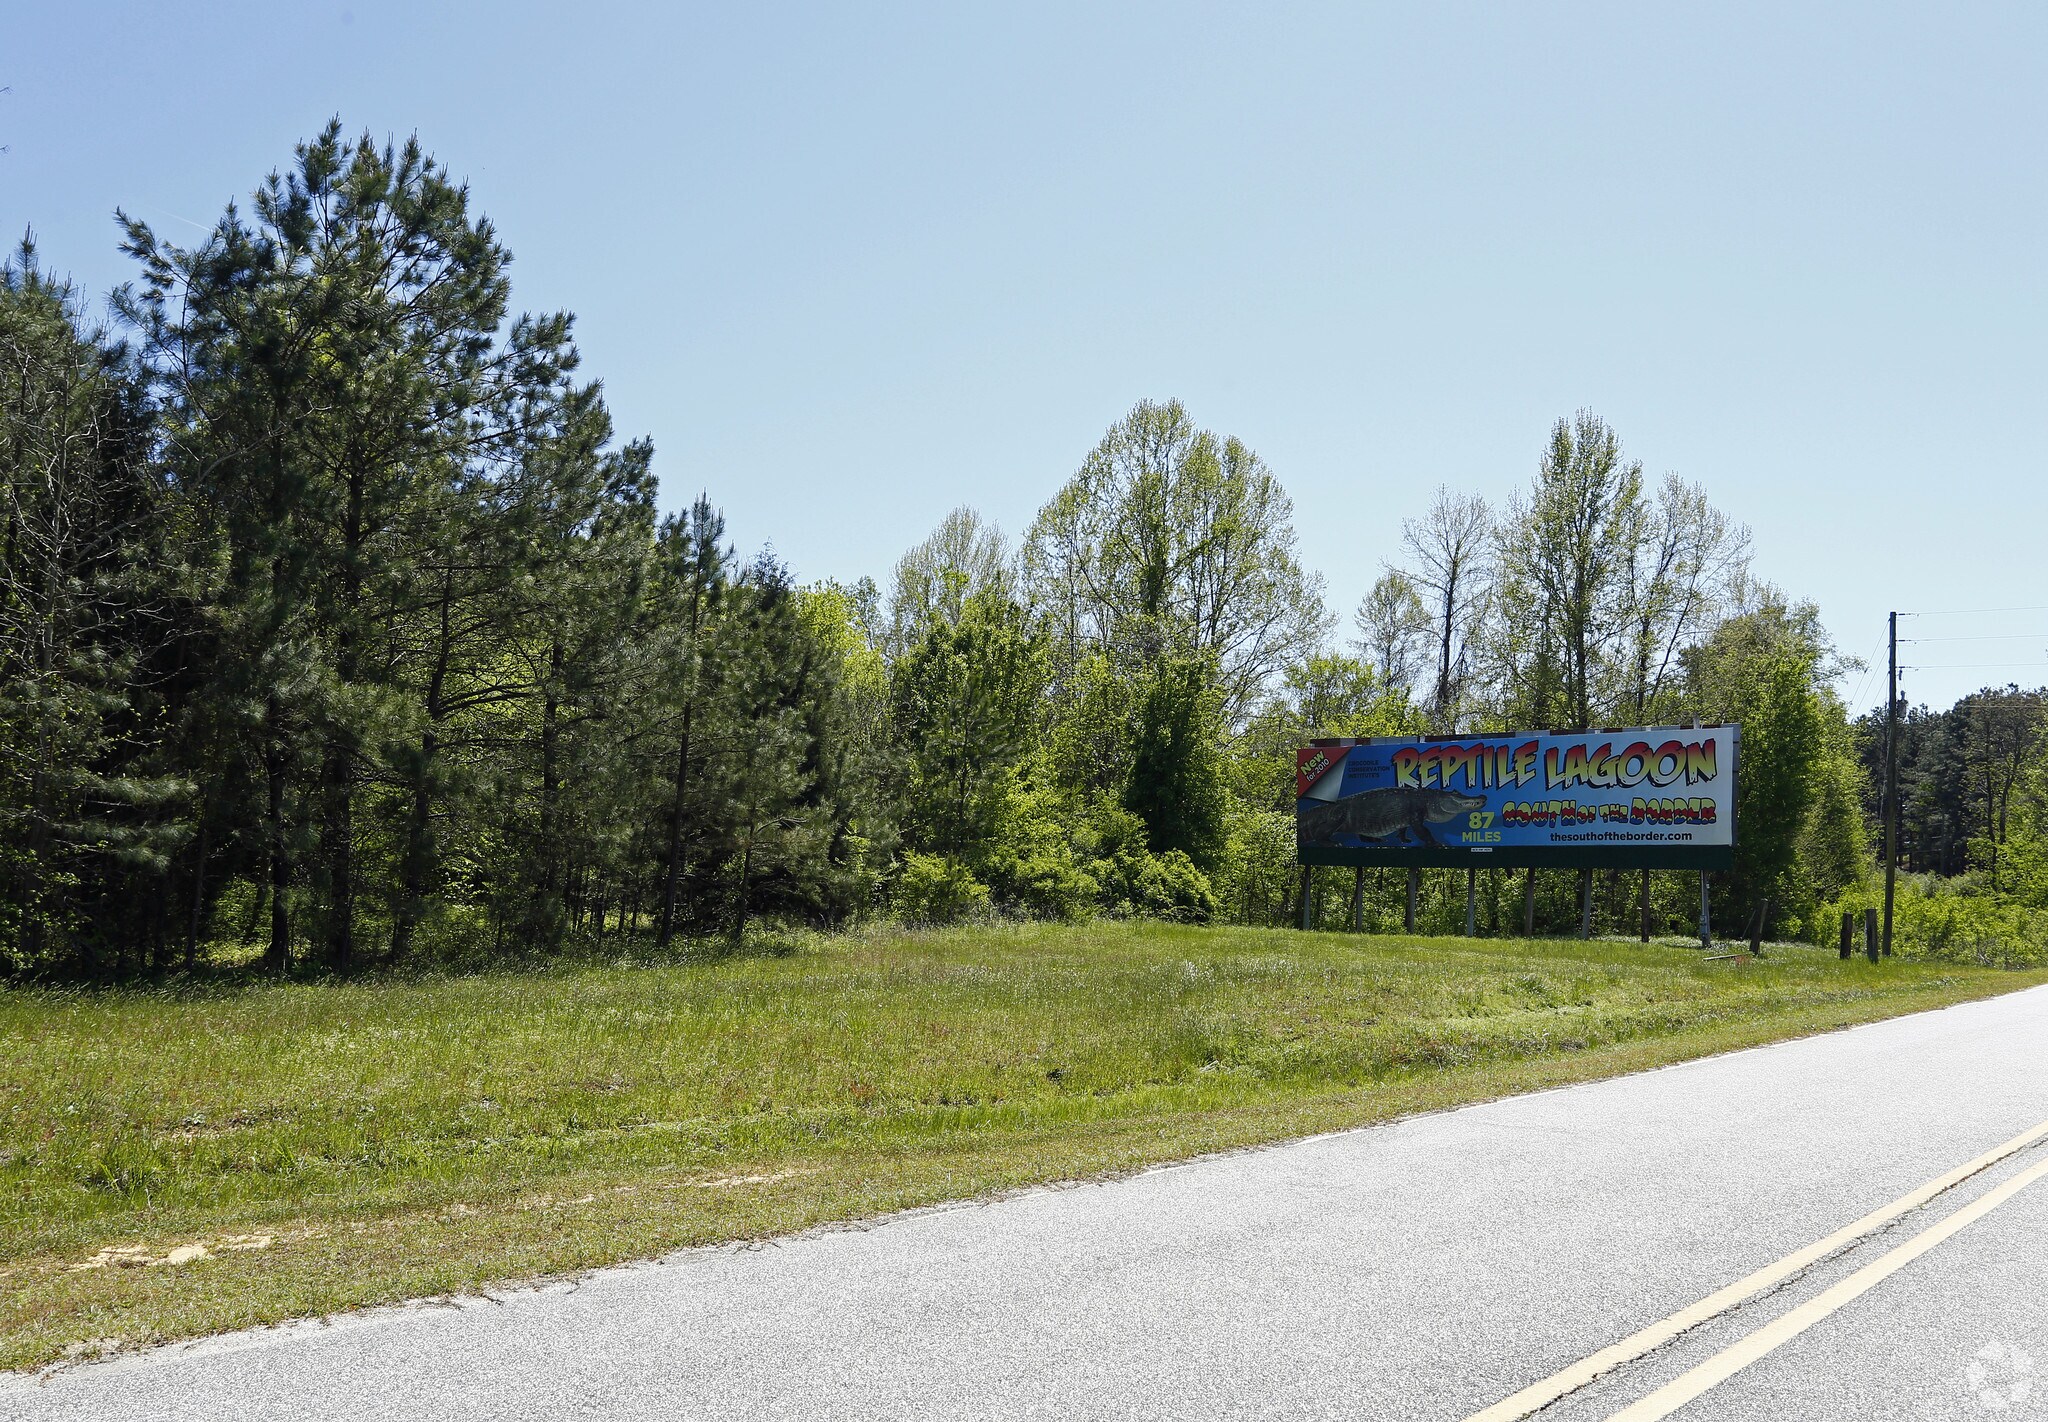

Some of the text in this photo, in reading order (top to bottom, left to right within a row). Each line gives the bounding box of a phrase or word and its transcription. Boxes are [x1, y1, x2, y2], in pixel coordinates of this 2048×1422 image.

[1300, 751, 1325, 775] New
[1306, 758, 1330, 781] for 2010
[1392, 739, 1718, 790] REPTILE LAGOON
[1469, 812, 1494, 829] 87
[1502, 800, 1576, 828] SOUTH
[1600, 804, 1628, 823] THE
[1630, 797, 1717, 825] BORDER
[1462, 831, 1501, 843] MILES
[1550, 831, 1692, 842] thesouthoftheborder.com
